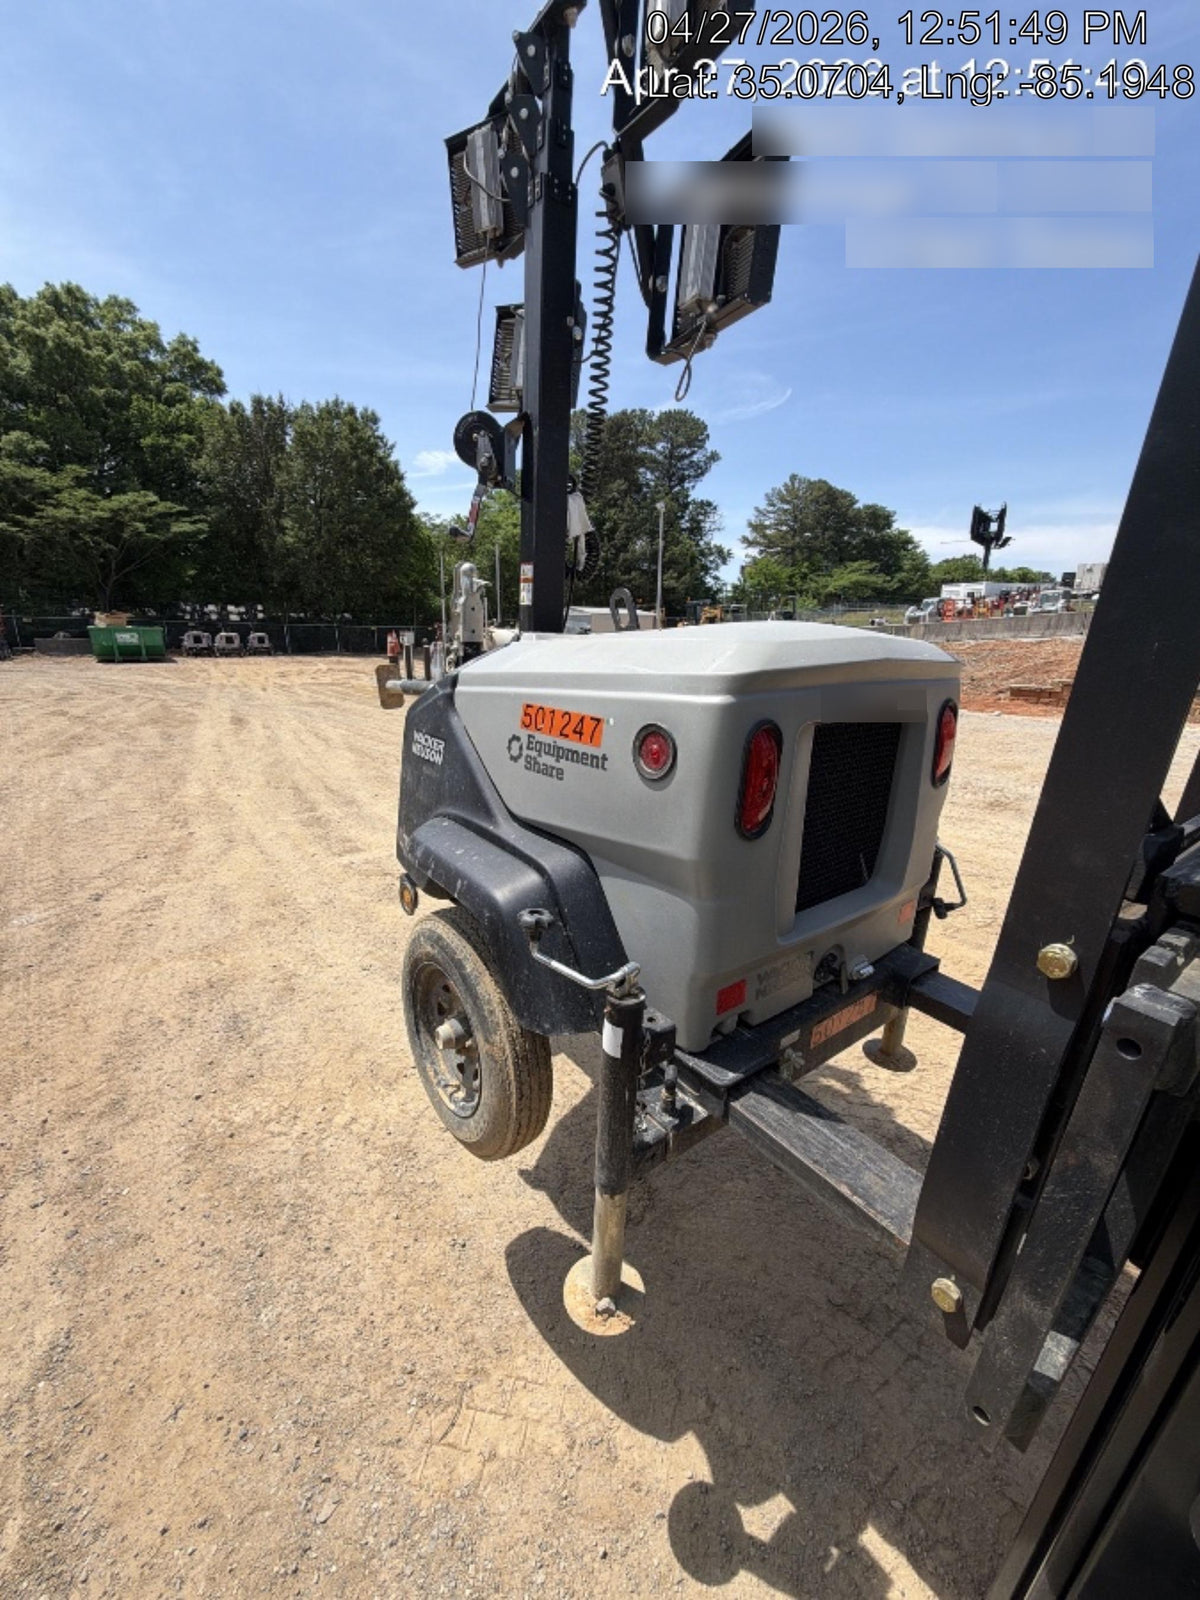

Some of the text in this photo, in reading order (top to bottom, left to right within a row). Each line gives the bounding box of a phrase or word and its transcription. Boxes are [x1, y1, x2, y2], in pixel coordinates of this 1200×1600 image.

[522, 704, 602, 744] 501247
[523, 753, 565, 781] Share
[525, 734, 609, 772] Equipment
